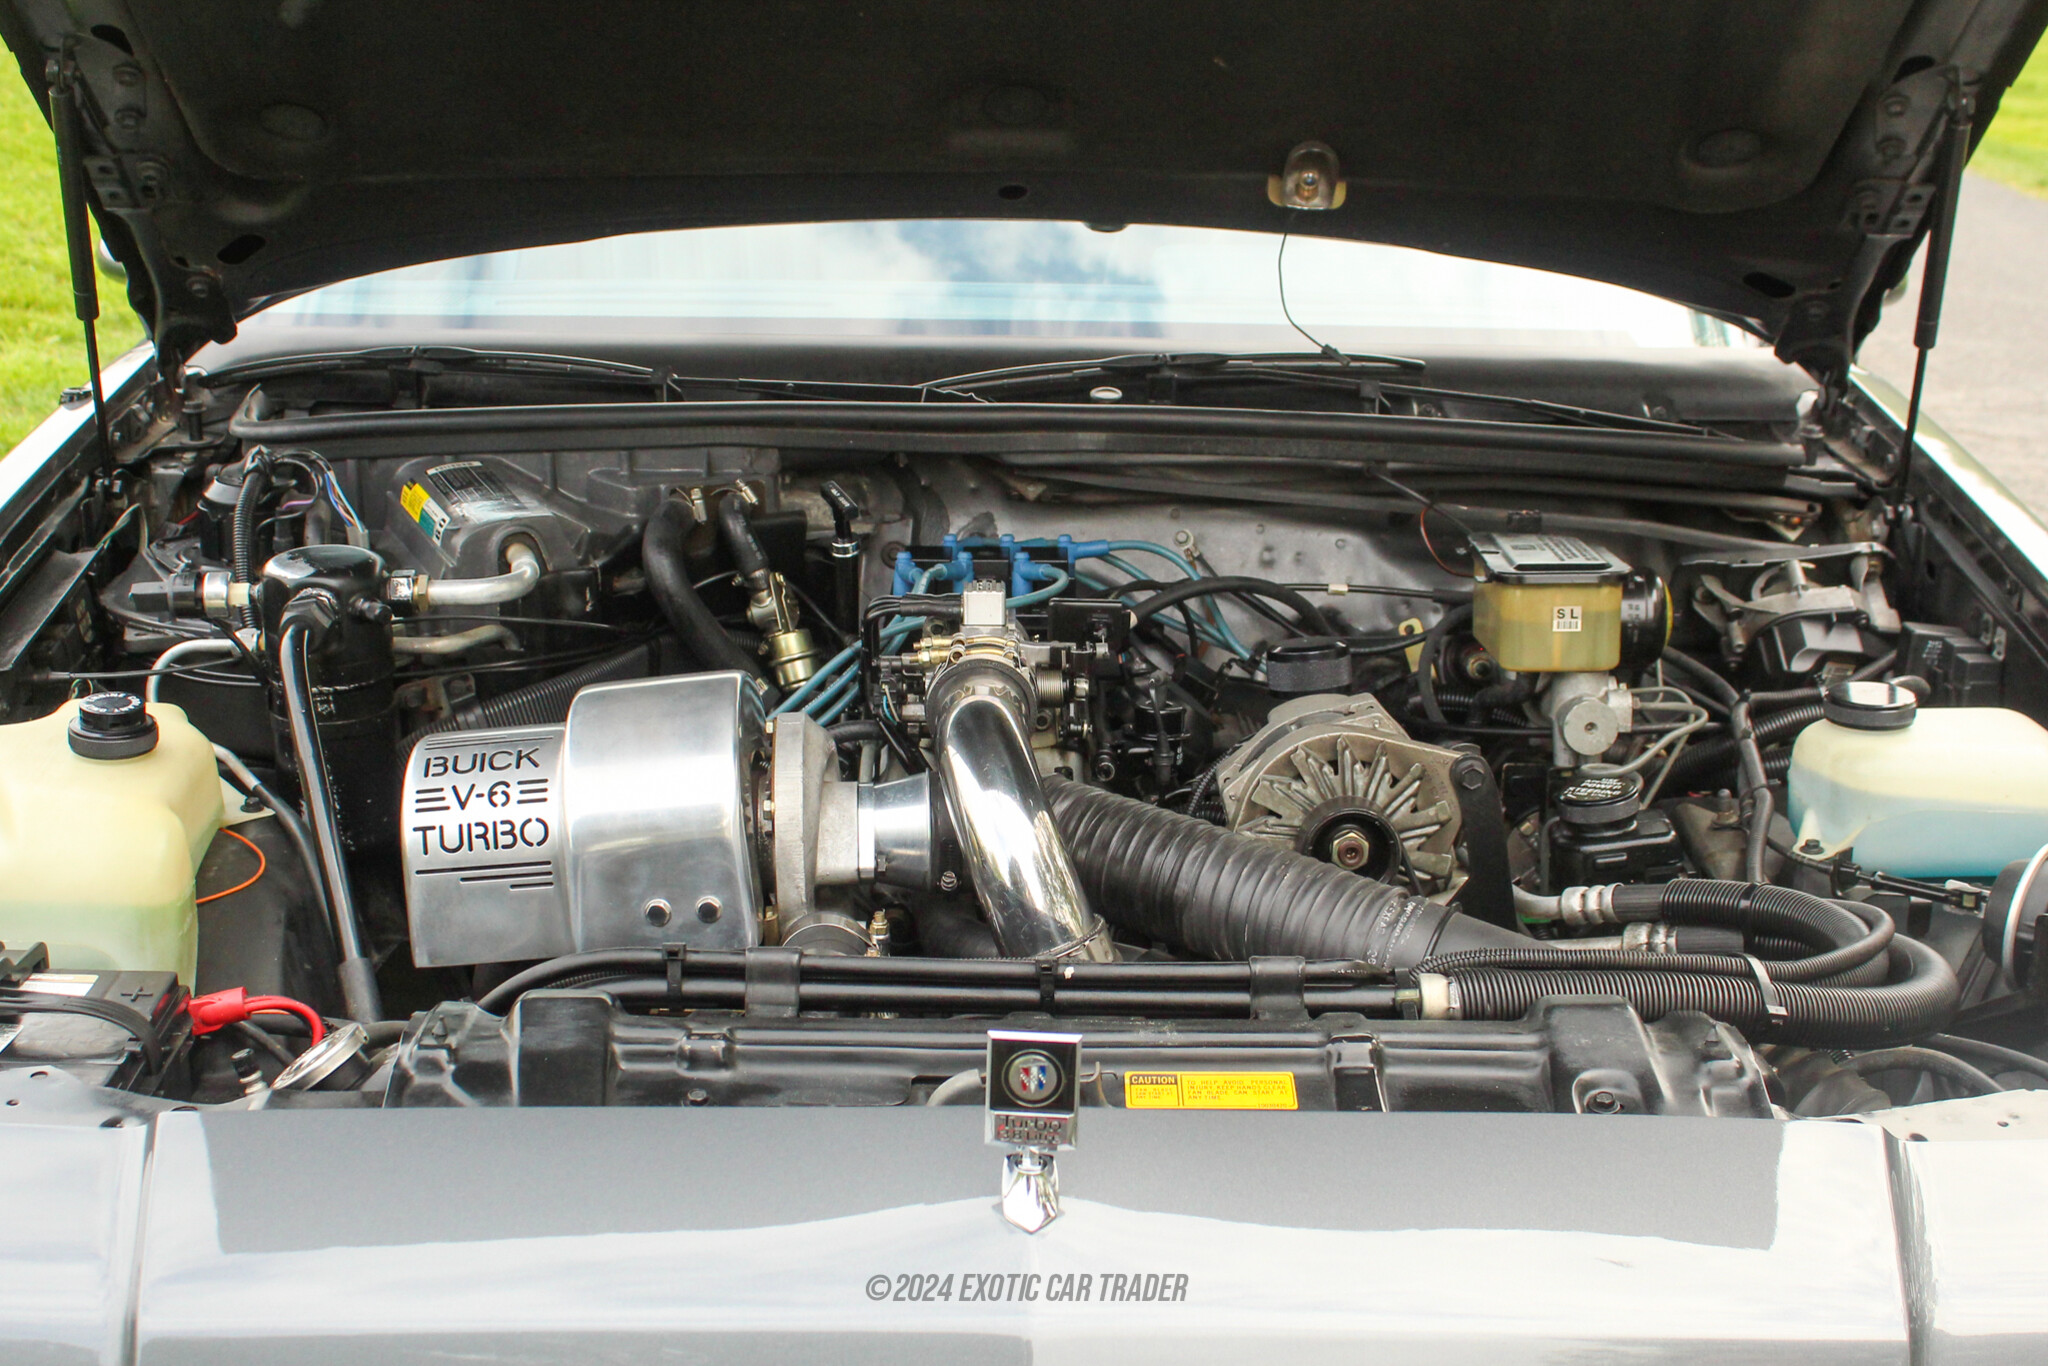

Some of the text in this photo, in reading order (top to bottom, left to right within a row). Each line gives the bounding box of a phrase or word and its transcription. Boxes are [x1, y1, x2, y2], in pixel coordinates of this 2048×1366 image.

[1557, 608, 1579, 619] S L
[424, 748, 540, 778] BUICK
[451, 780, 511, 810] V-6
[413, 817, 549, 855] TURBO
[1131, 1075, 1175, 1084] CAUTION
[1000, 1115, 1062, 1131] Turbo
